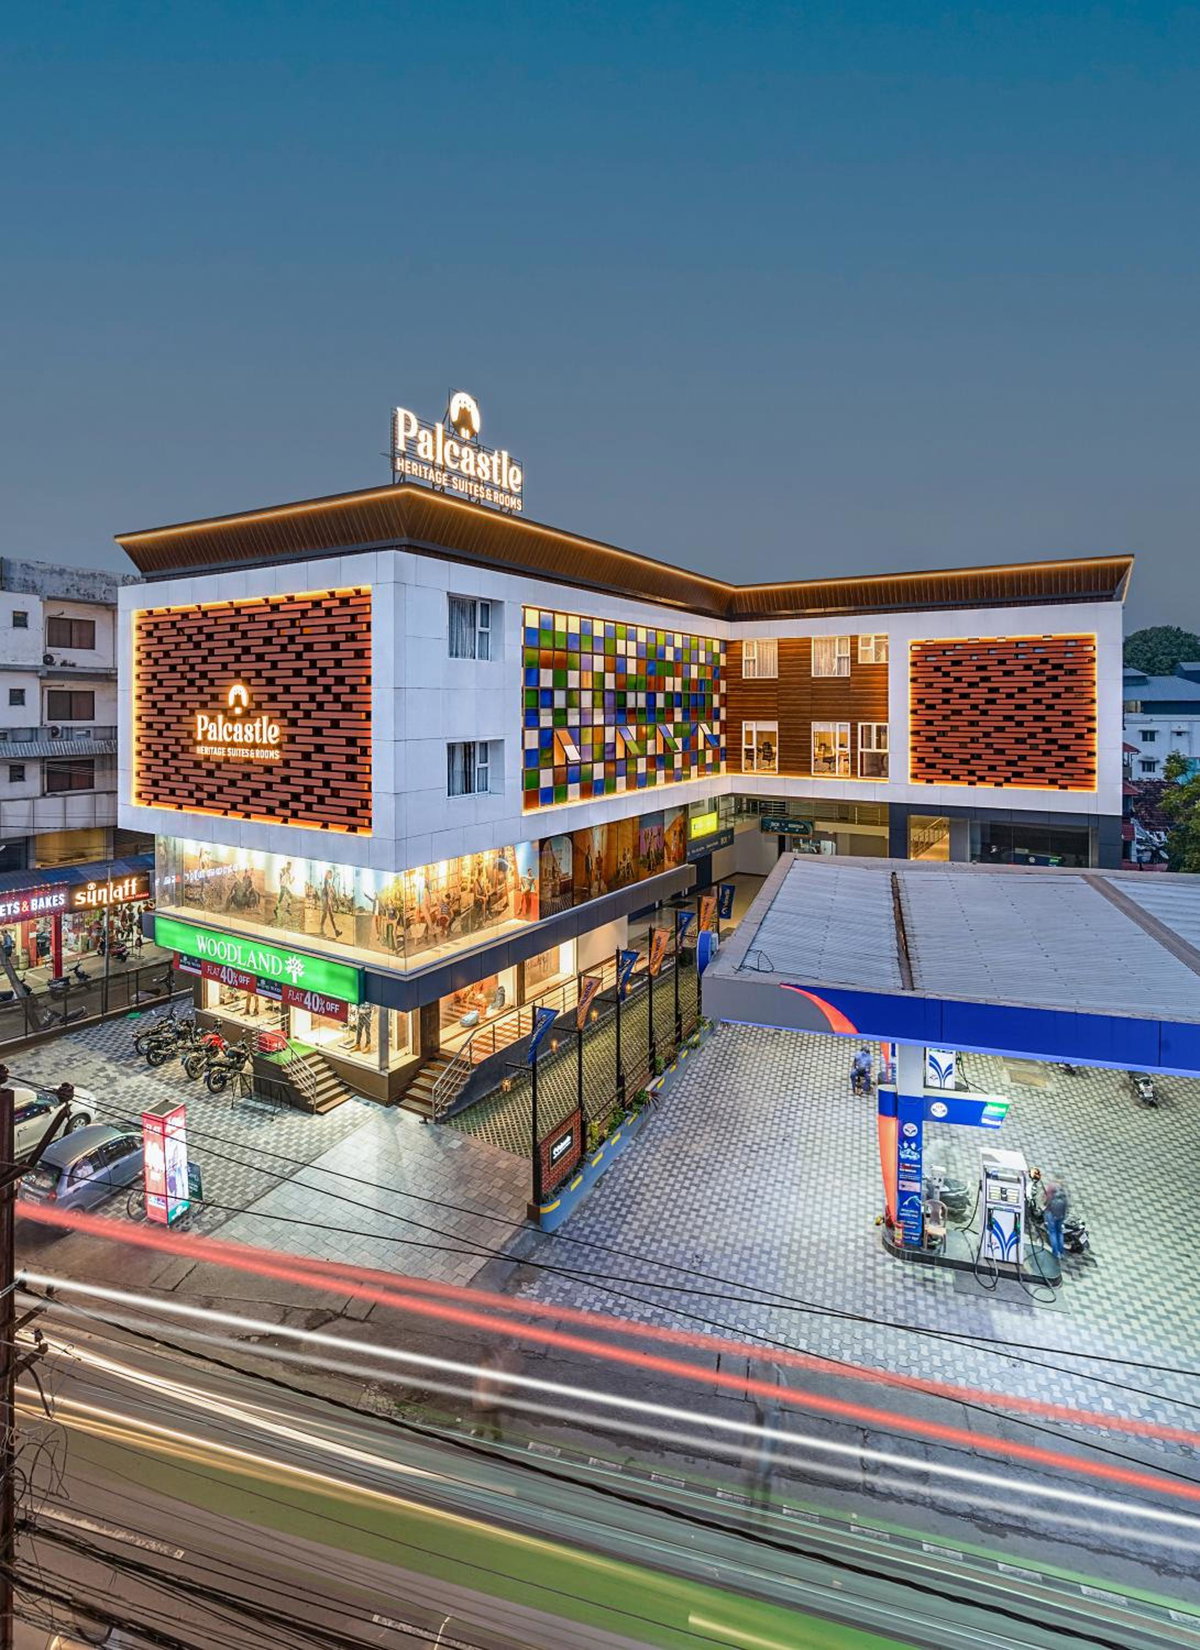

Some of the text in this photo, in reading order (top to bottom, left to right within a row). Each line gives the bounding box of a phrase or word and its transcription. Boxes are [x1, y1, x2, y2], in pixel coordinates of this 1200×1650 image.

[397, 407, 522, 492] Palcastle
[396, 457, 449, 486] HERITAGE
[196, 715, 280, 745] Palcastle
[196, 746, 227, 757] HERITAGE
[21, 901, 29, 912] &
[30, 893, 65, 911] BAKES
[195, 934, 283, 976] WOODLAND
[206, 965, 251, 986] FLAT 40% OFF
[287, 990, 340, 1014] FLAT 40% OFF
